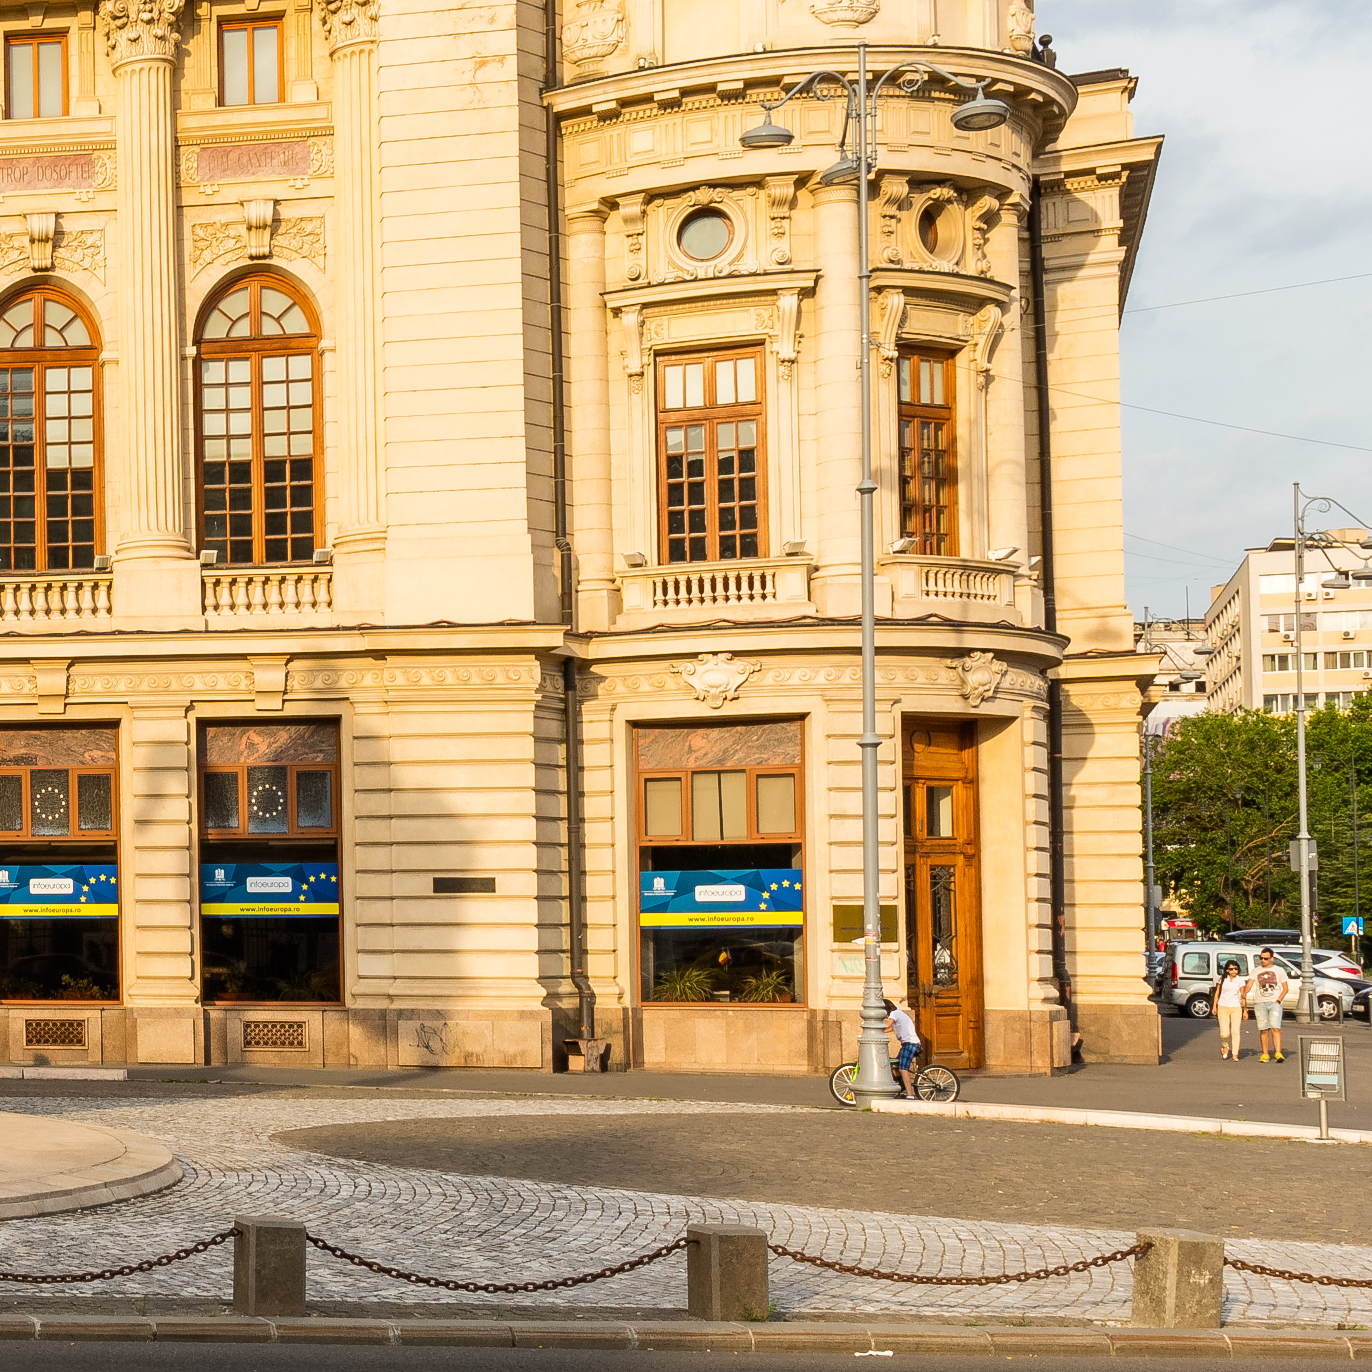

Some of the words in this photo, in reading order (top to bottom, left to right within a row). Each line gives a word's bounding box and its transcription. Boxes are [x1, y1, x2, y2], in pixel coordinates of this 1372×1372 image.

[32, 881, 70, 891] infoeuropa
[249, 879, 289, 890] infoeuropa
[698, 887, 742, 898] infoeuropa
[688, 912, 754, 922] www.infoeuropa.ro
